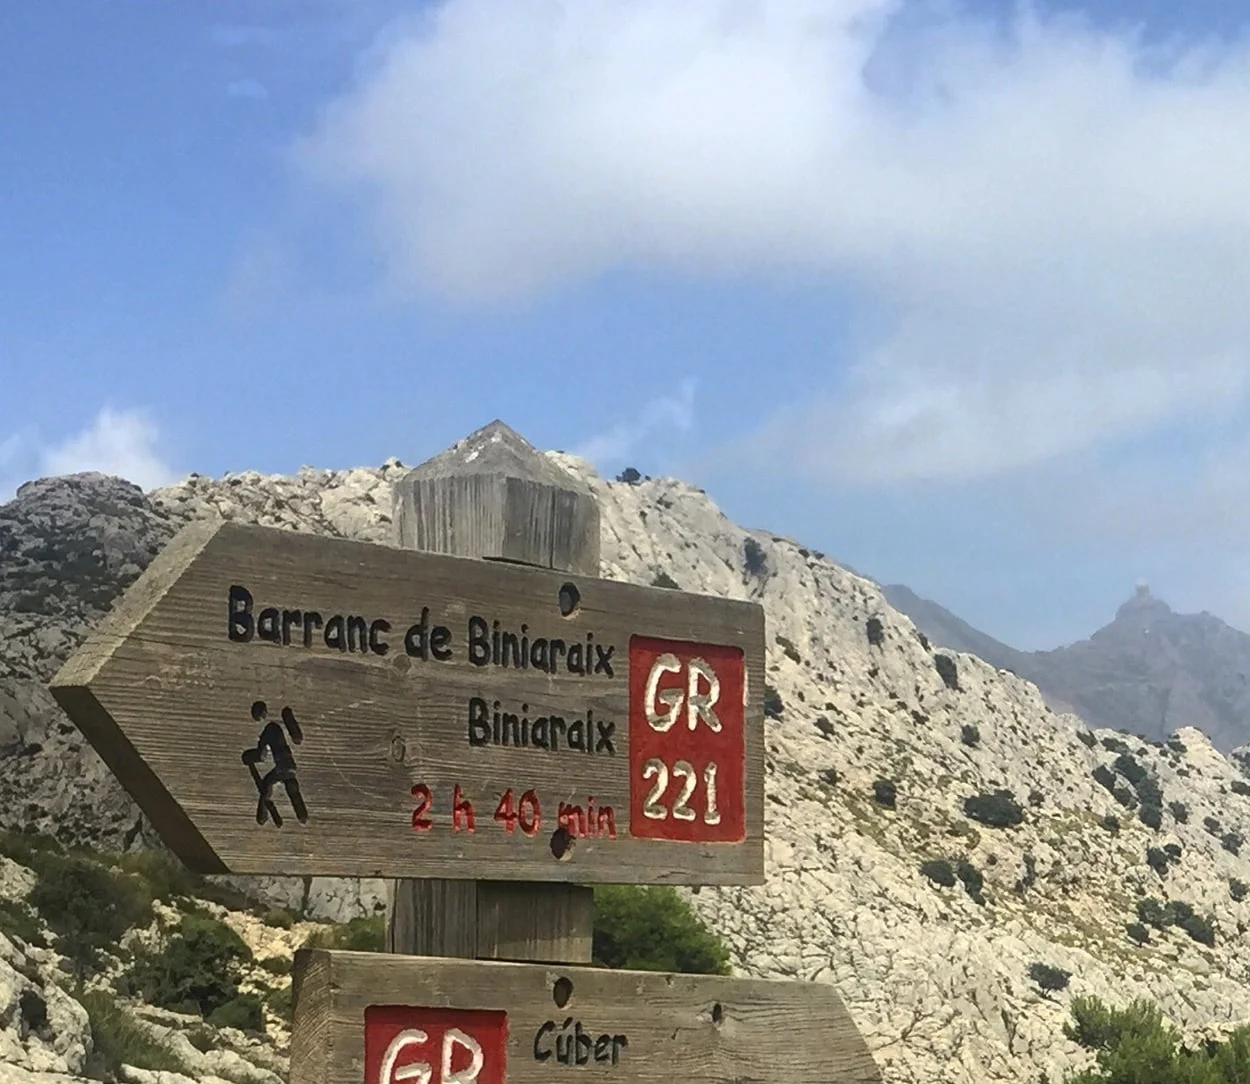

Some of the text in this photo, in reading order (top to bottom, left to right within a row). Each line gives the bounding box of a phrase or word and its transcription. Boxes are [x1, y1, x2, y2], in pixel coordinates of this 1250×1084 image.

[228, 585, 614, 678] Barranc de Biniaraix
[644, 653, 723, 733] GR
[468, 696, 616, 755] Biniaraix
[411, 783, 617, 840] 2 h 40 min
[643, 757, 721, 826] 221
[533, 1017, 629, 1065] Cúber
